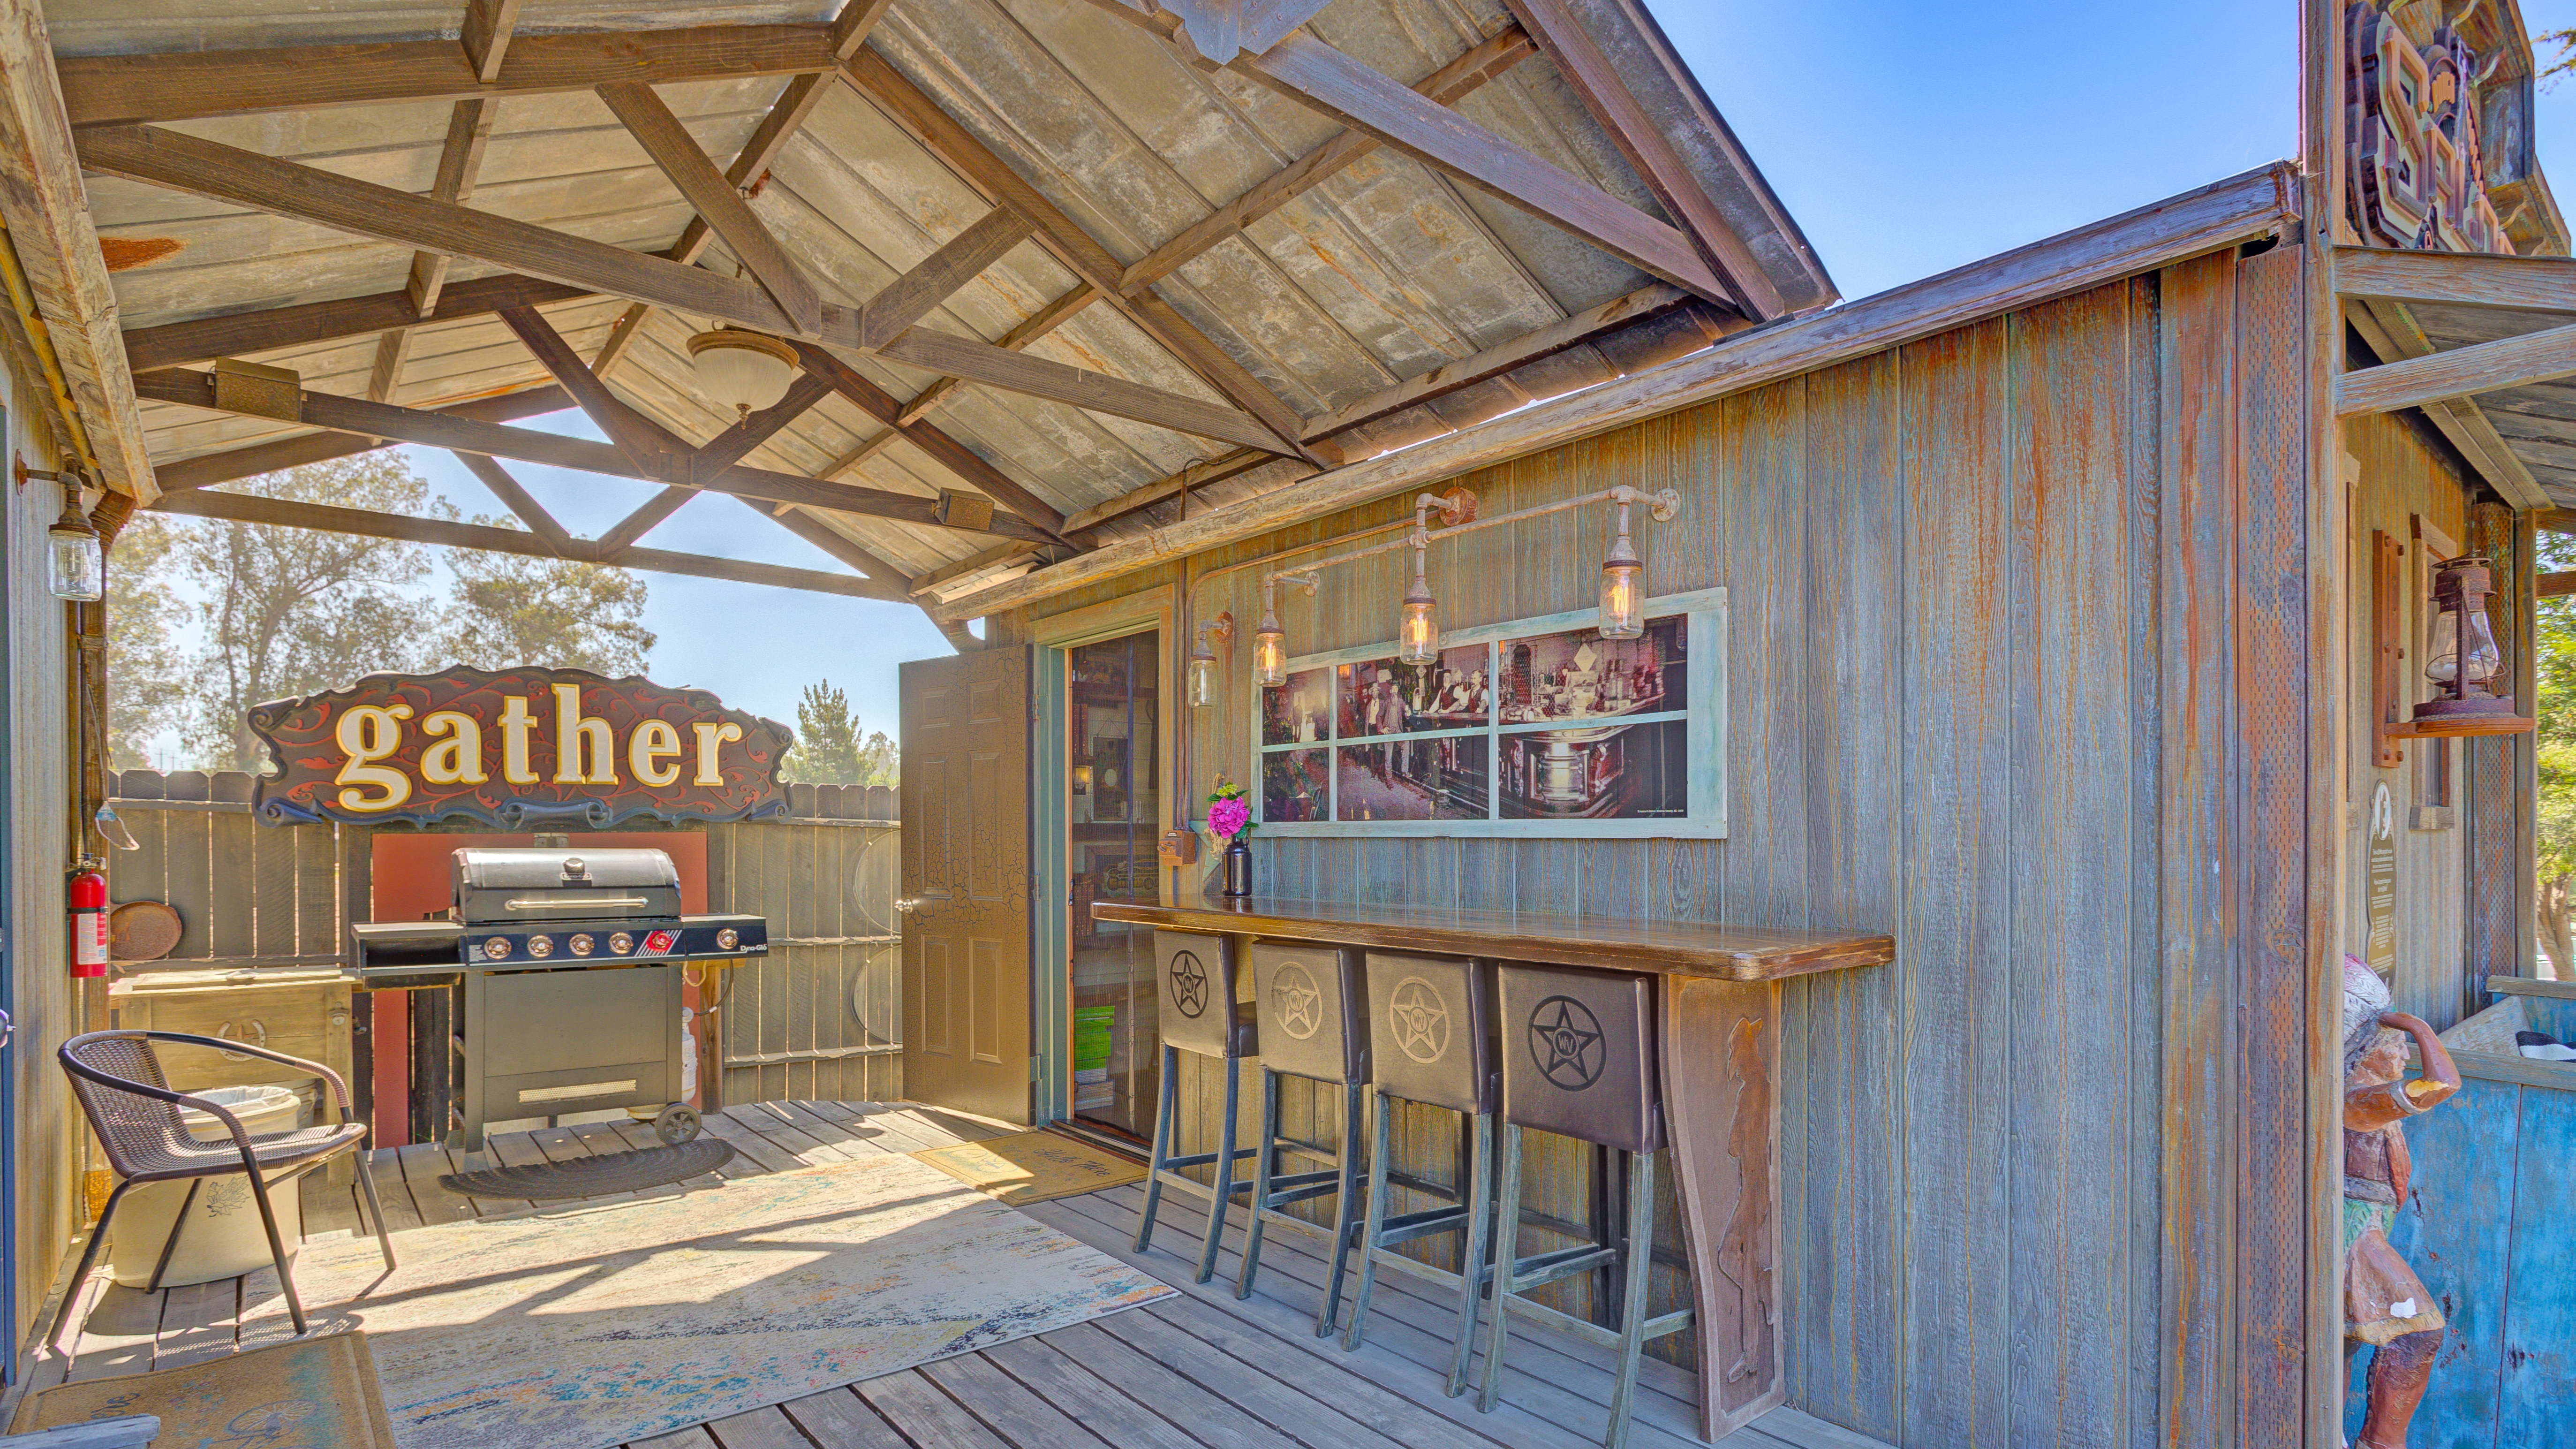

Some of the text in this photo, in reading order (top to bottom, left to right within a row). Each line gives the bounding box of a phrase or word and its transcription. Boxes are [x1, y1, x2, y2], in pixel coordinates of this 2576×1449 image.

[334, 683, 742, 812] gather
[740, 943, 767, 952] Dyna-Glo
[1033, 1148, 1110, 1177] Hello There
